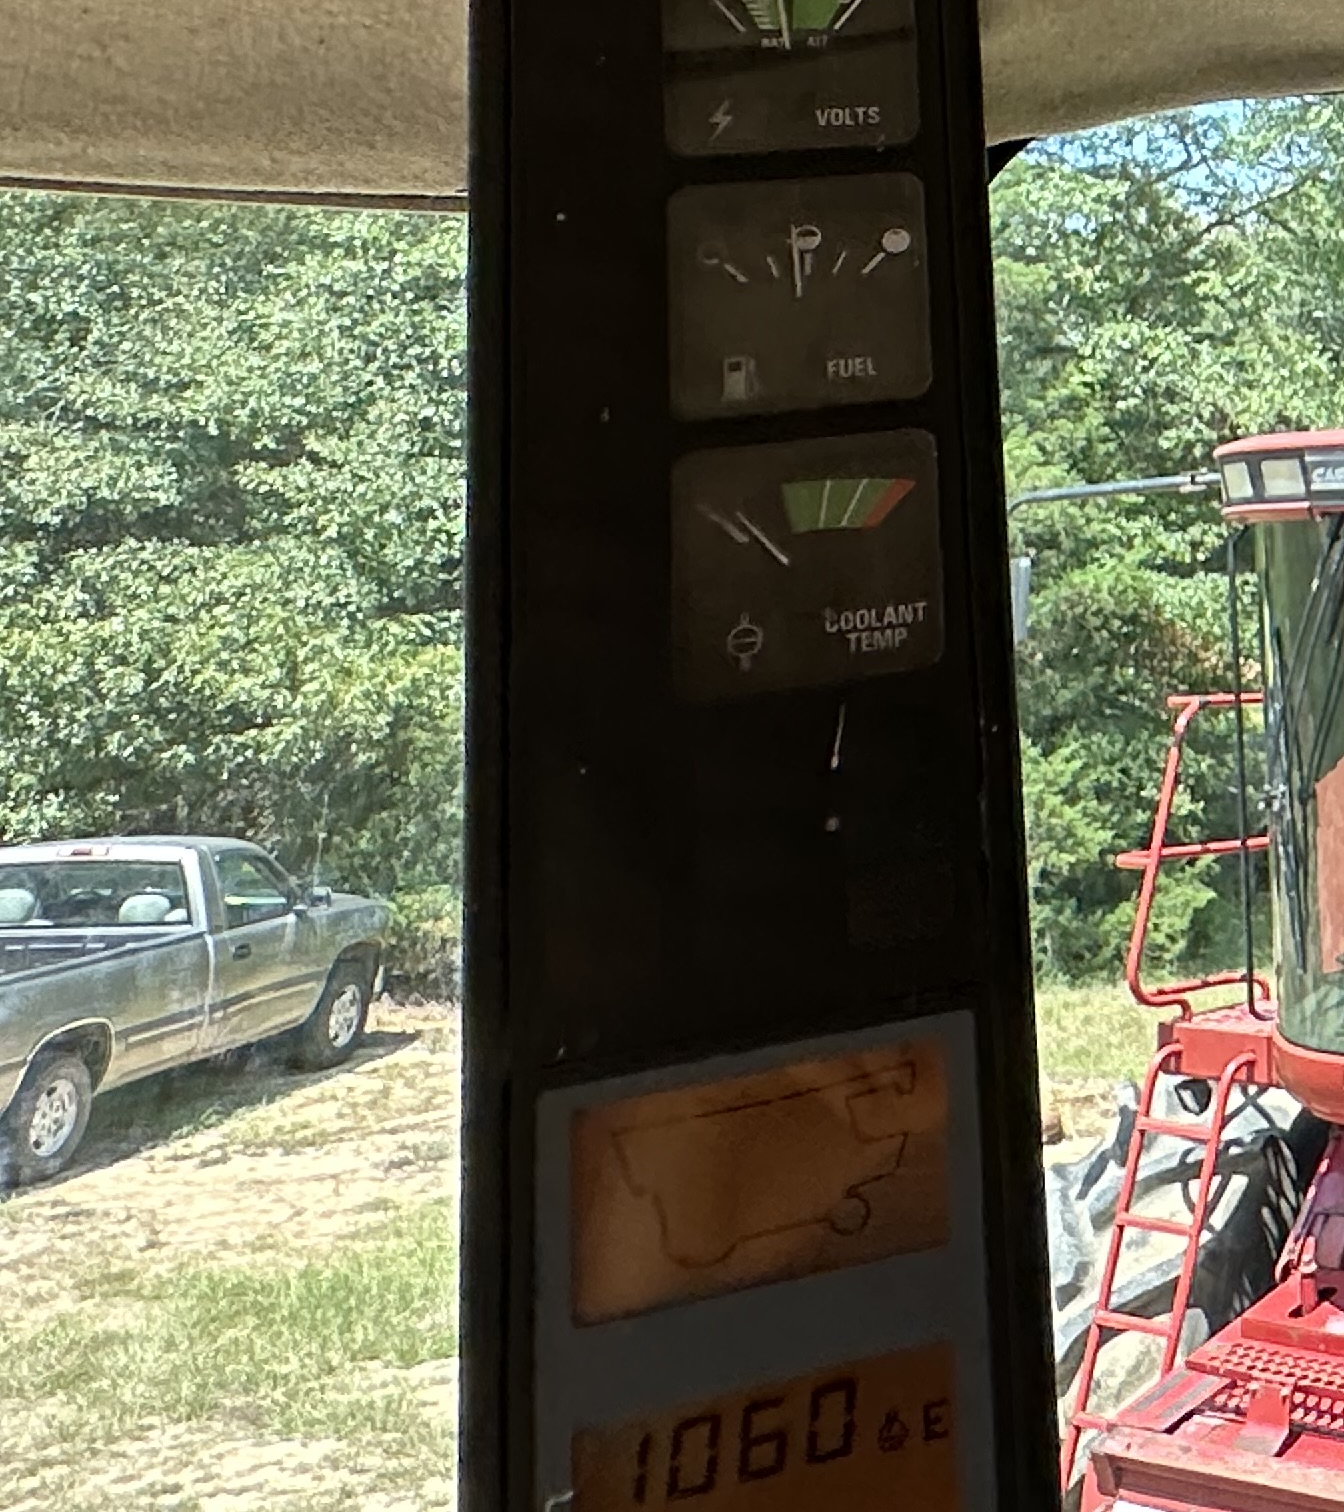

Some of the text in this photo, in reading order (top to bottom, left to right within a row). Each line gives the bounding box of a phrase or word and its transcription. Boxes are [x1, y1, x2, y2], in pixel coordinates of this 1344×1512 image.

[815, 105, 881, 126] VOLTS
[826, 355, 878, 380] FUEL
[824, 600, 928, 634] COOLANT
[845, 626, 909, 653] TEMP
[632, 1376, 859, 1505] 1060
